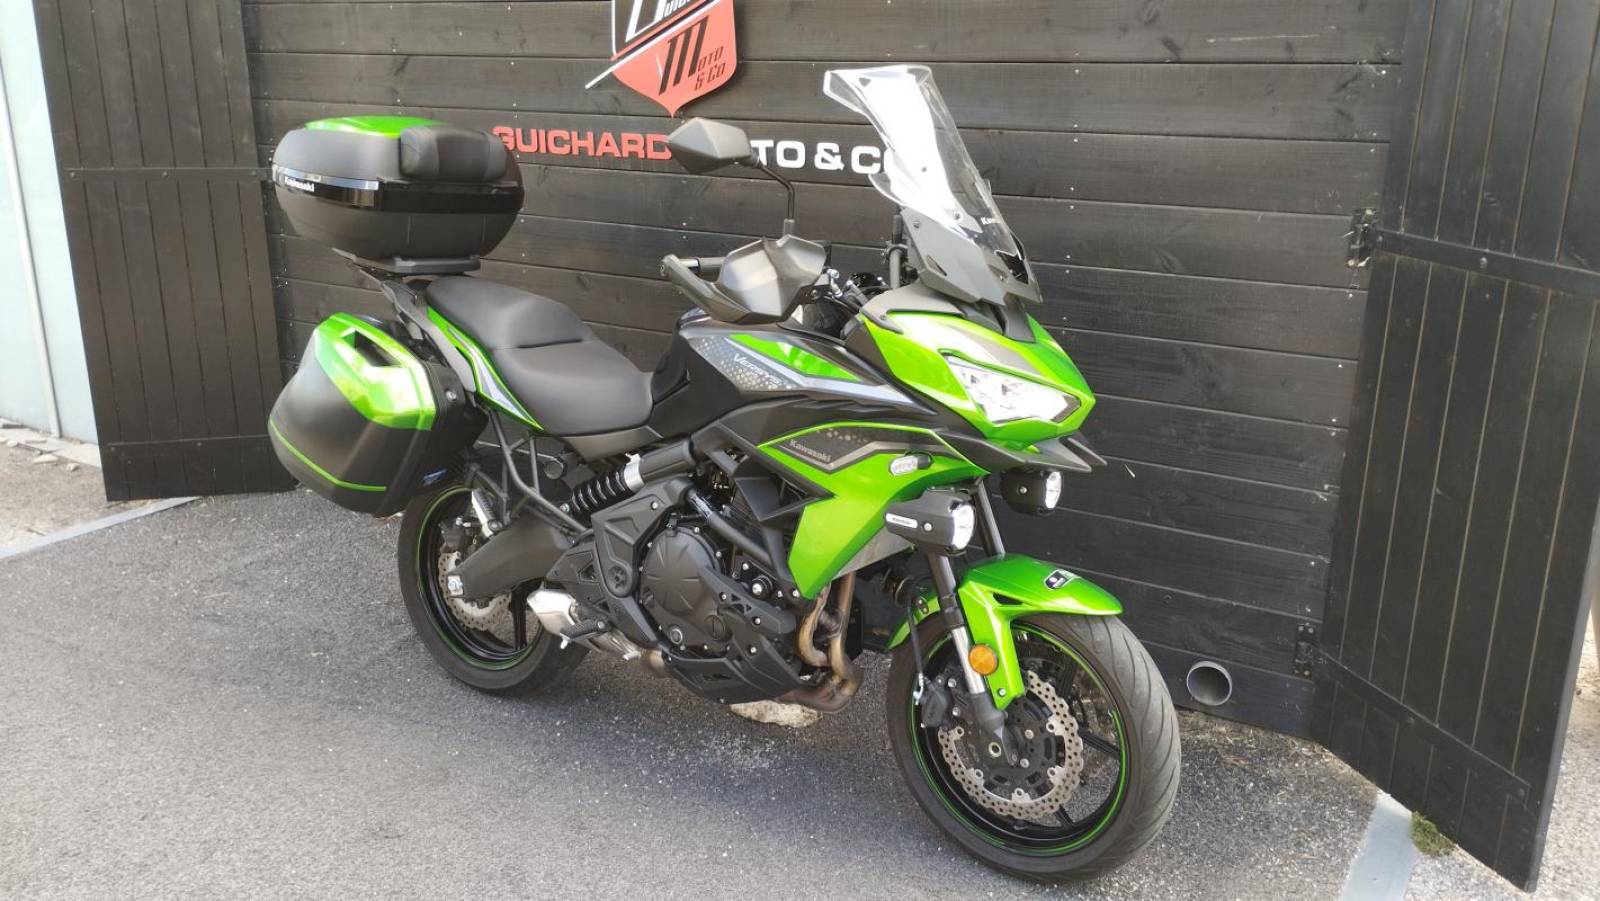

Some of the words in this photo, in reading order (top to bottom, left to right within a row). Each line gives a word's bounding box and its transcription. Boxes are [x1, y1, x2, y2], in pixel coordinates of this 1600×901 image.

[492, 126, 672, 160] GUICHARD
[750, 139, 806, 169] TO
[814, 142, 845, 171] &
[851, 146, 888, 174] C
